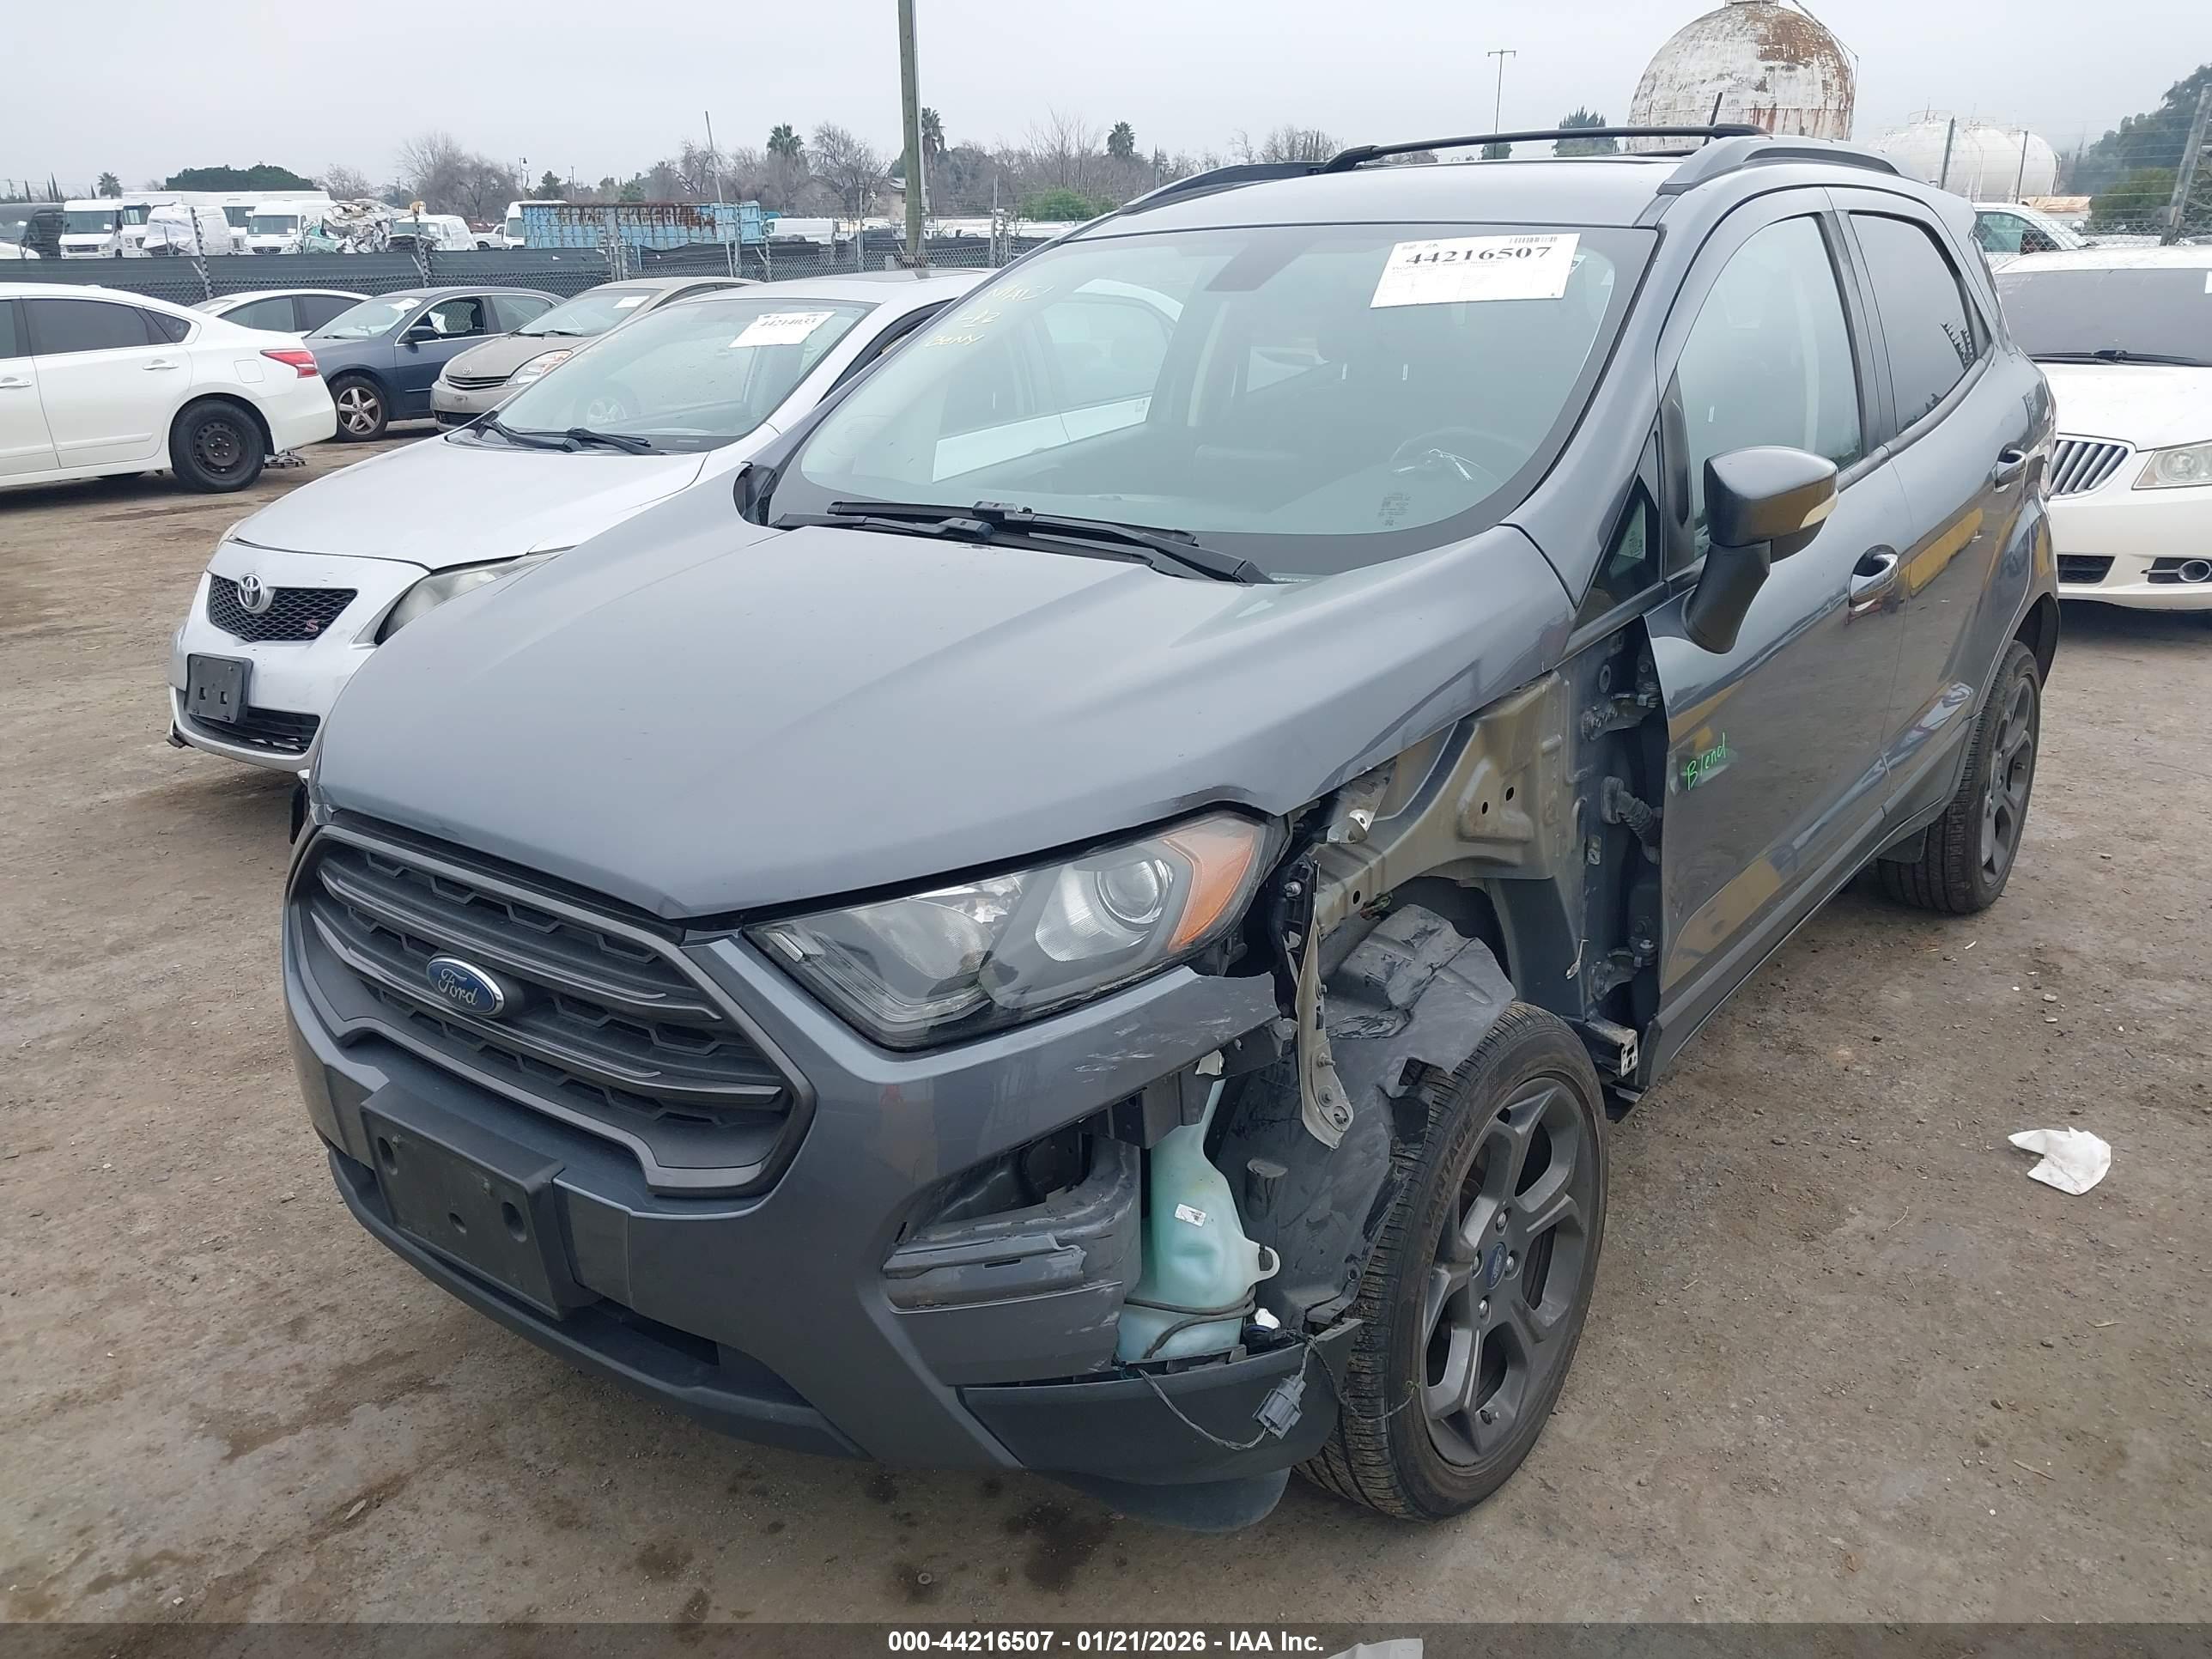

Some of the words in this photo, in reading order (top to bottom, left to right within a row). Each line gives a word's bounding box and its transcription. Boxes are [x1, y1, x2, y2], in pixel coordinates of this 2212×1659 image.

[1406, 246, 1552, 265] 44216507
[1686, 731, 1727, 791] Blend
[438, 968, 478, 1006] Ford
